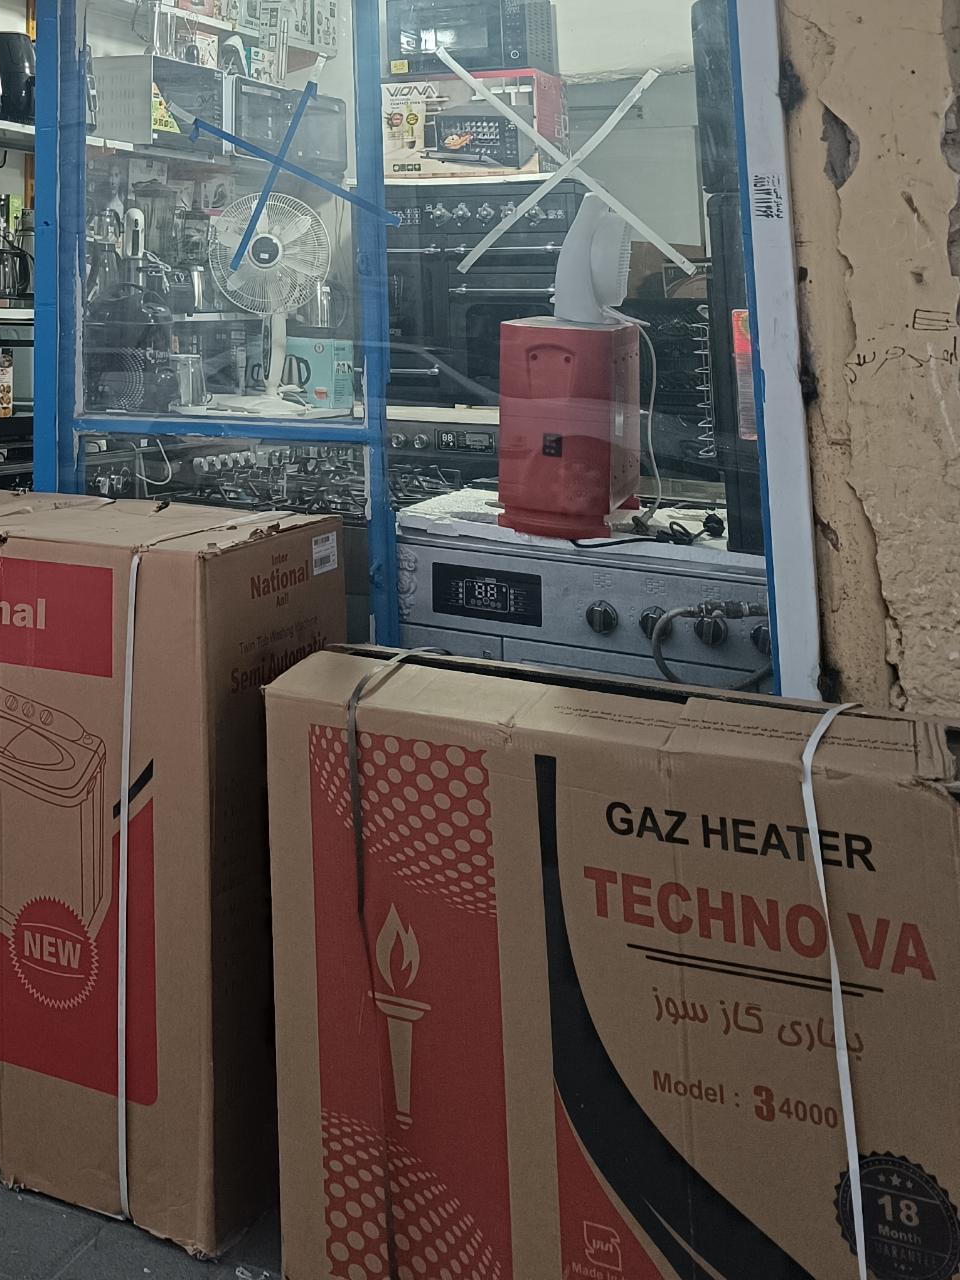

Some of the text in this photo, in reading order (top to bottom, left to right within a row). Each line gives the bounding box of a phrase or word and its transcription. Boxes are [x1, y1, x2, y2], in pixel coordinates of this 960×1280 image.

[386, 85, 438, 98] VIONA
[271, 552, 288, 567] Inter
[249, 559, 309, 600] National
[275, 594, 289, 609] Anil
[239, 641, 255, 655] Twin
[230, 657, 265, 694] Semi
[604, 801, 877, 872] GAZ HEATER
[23, 930, 82, 969] NEW
[652, 986, 709, 1023] سوز
[721, 999, 764, 1036] گاز
[652, 1070, 725, 1105] Model
[753, 1084, 839, 1130] 34000
[877, 1193, 921, 1228] 18
[877, 1223, 923, 1246] Month
[571, 1261, 605, 1280] Made
